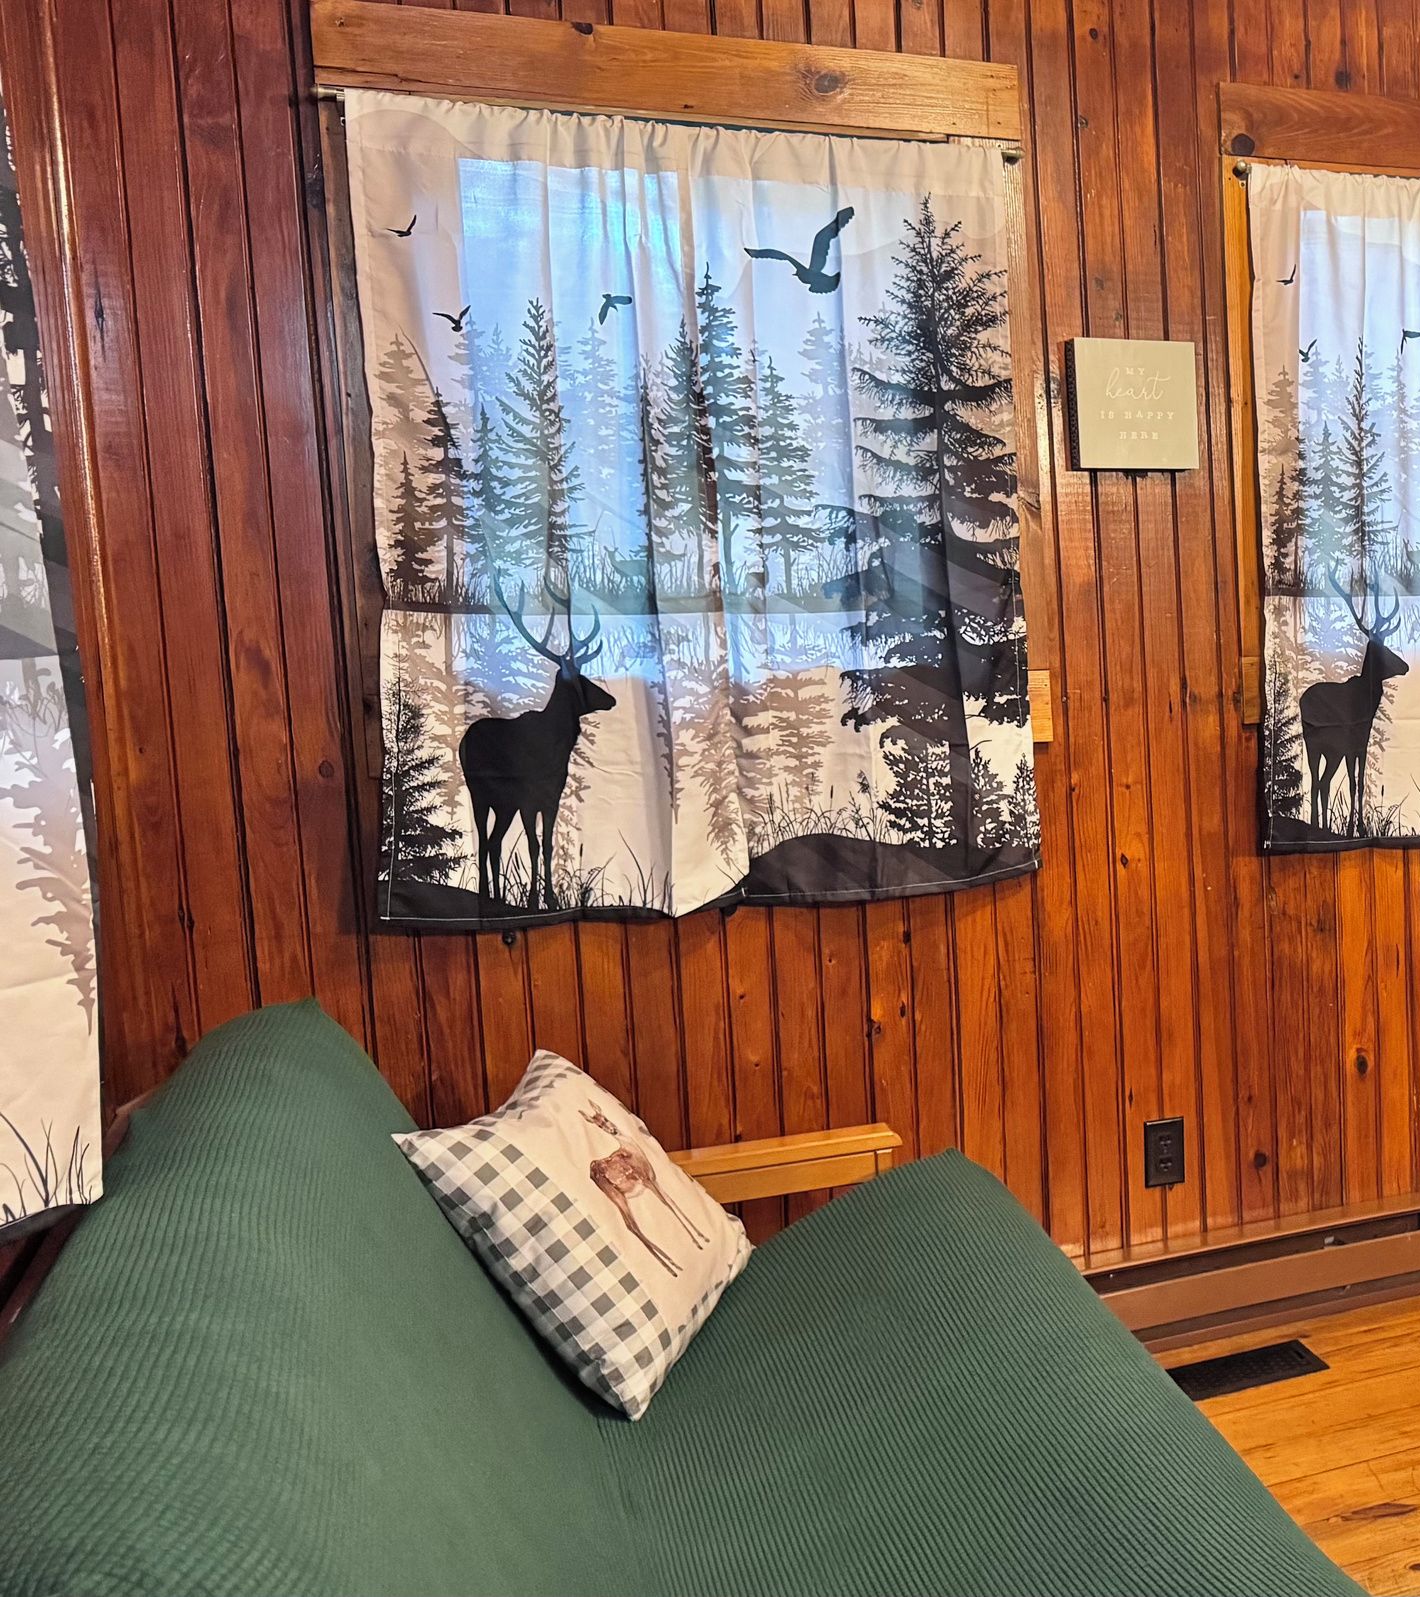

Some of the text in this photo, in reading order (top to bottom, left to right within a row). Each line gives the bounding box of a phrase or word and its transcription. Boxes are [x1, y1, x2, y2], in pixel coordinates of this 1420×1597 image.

[1126, 367, 1145, 376] MY
[1106, 367, 1171, 400] heart
[1100, 410, 1175, 420] IS HAPPY
[1119, 431, 1159, 440] HERE
